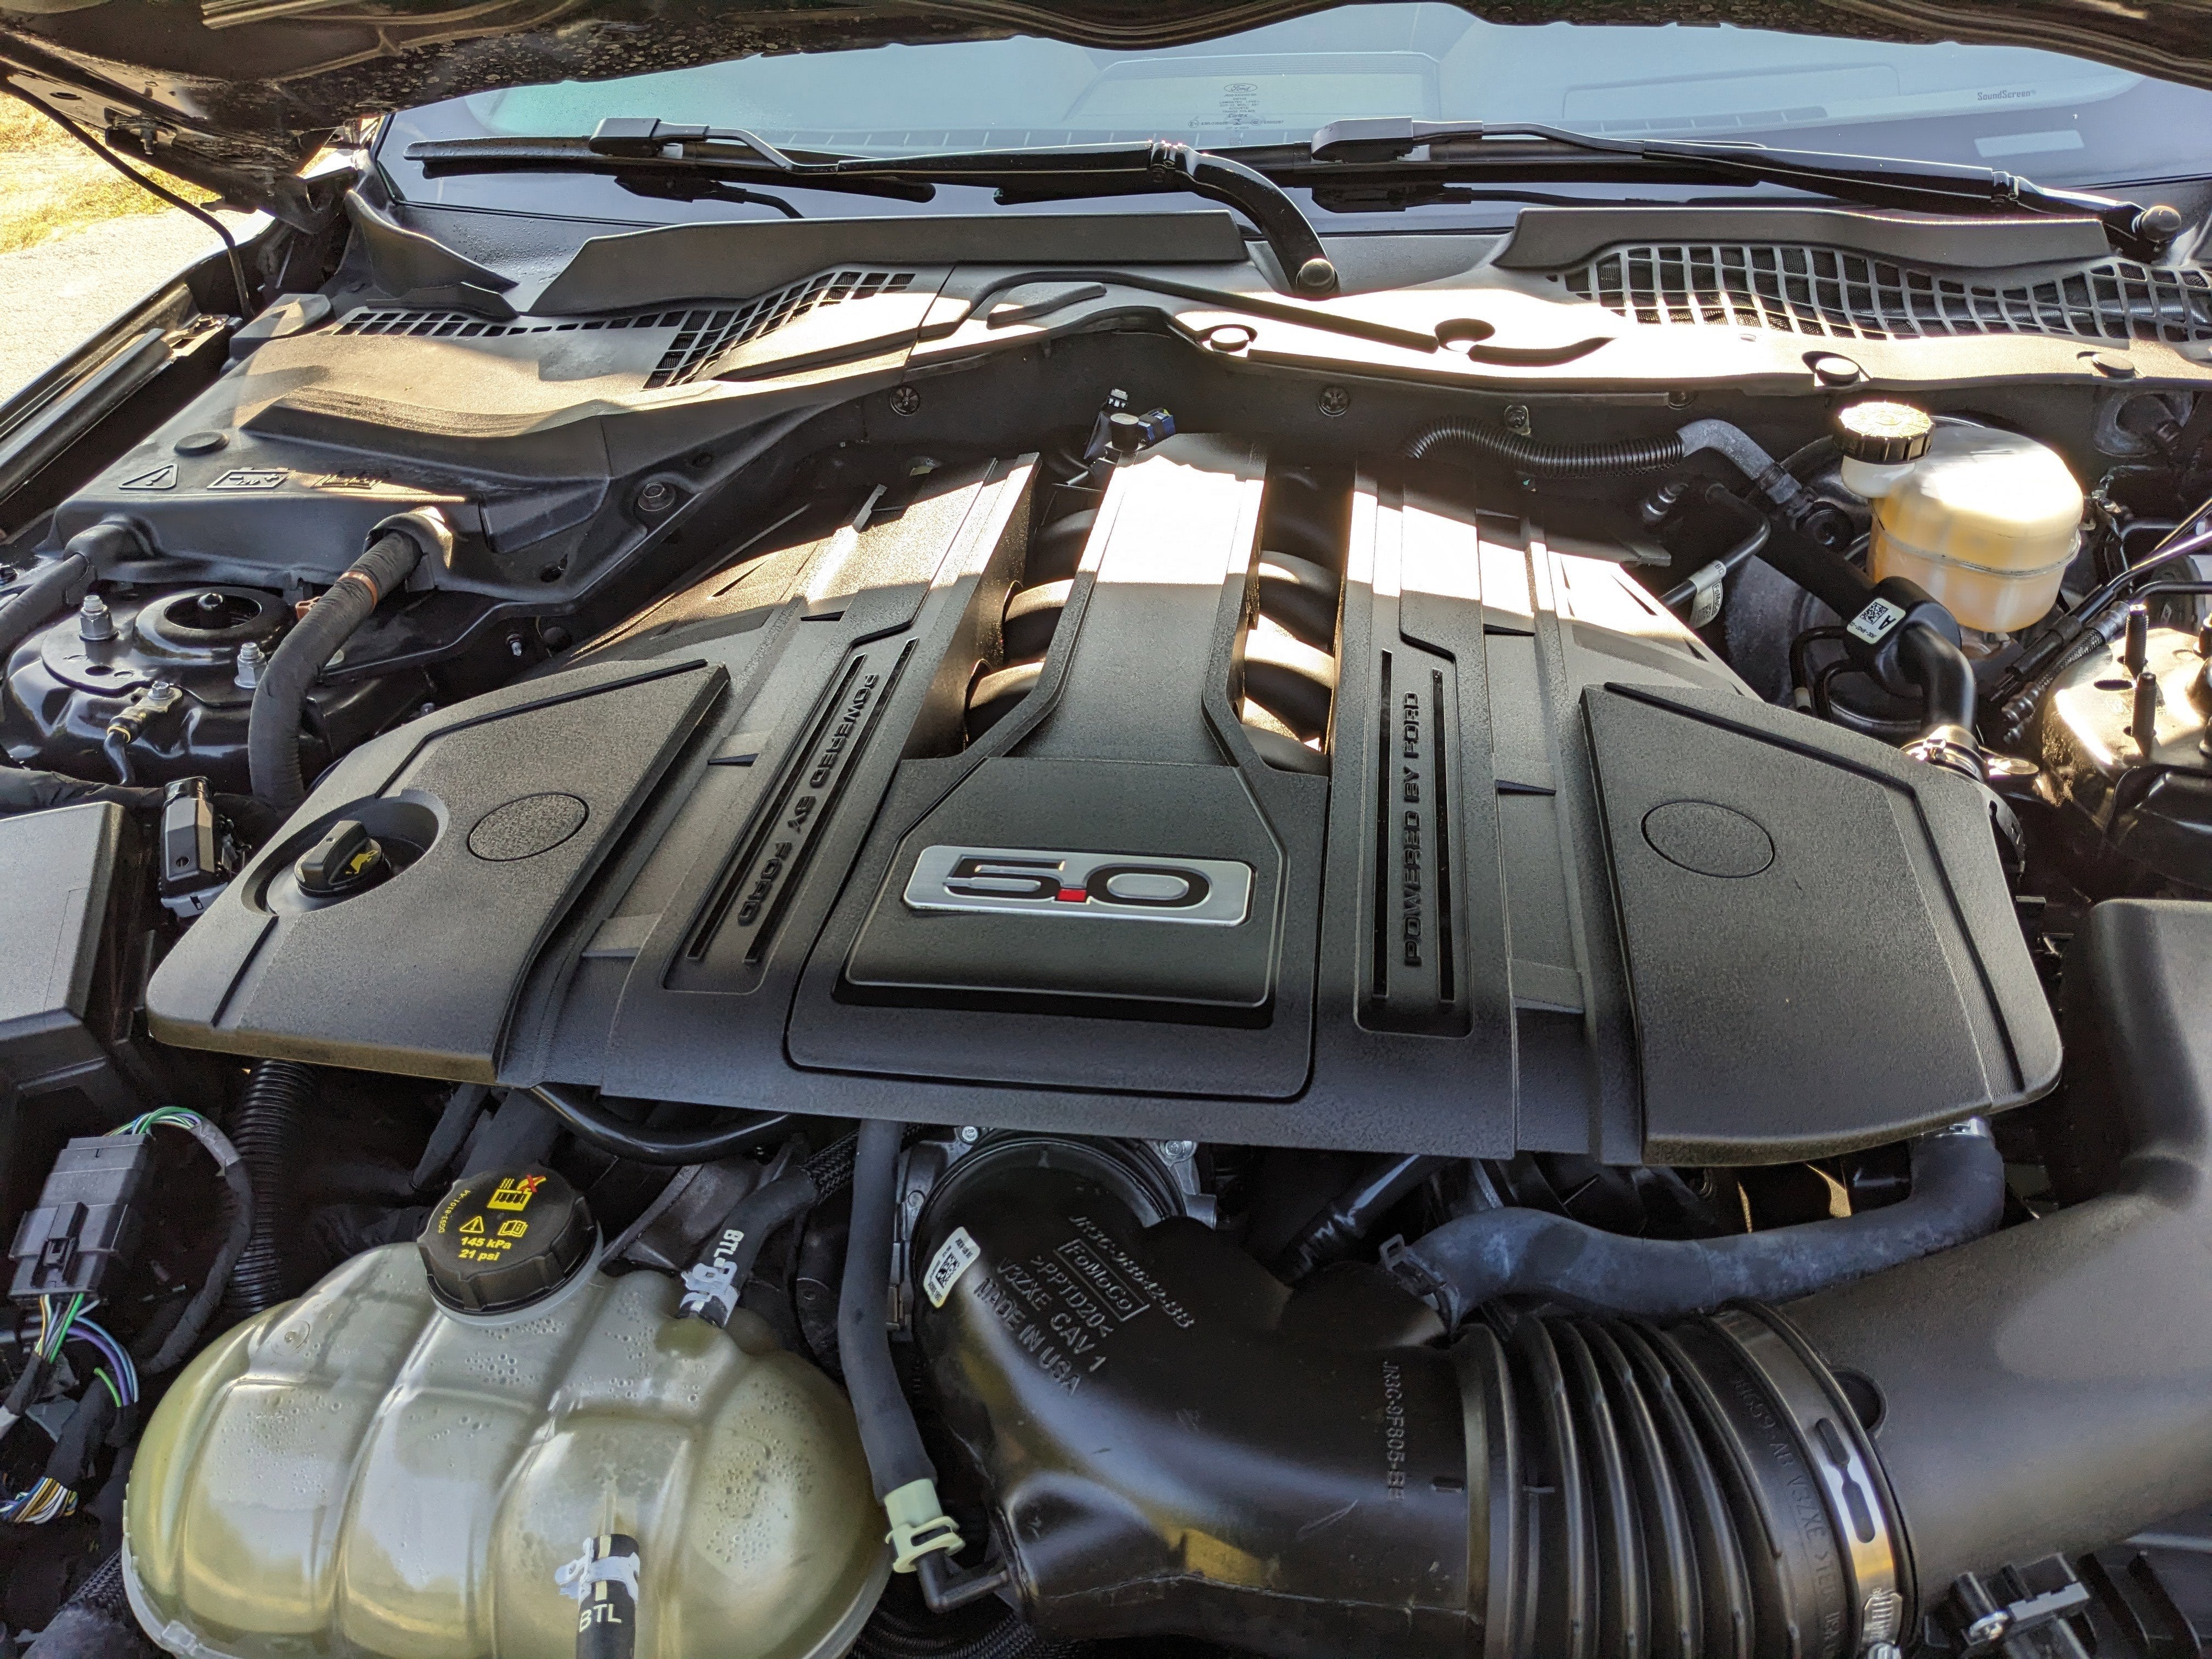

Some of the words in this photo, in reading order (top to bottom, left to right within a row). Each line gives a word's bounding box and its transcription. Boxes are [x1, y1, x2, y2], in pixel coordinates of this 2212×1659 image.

[1878, 614, 1897, 630] A
[809, 674, 879, 788] POWERED
[1403, 691, 1420, 759] FORD
[1403, 766, 1421, 803] BY
[787, 795, 816, 834] BY
[737, 842, 792, 926] FORD
[943, 854, 1212, 909] 5.0
[1403, 810, 1423, 966] POWERED
[459, 1249, 476, 1259] 21
[477, 1251, 500, 1261] psi
[460, 1237, 485, 1247] 145
[487, 1239, 511, 1250] kPa
[713, 1229, 744, 1258] BTL
[1066, 1244, 1134, 1312] FoMoCo
[973, 1278, 1027, 1331] MADE
[1019, 1323, 1046, 1352] IN
[1041, 1346, 1082, 1398] USA
[1050, 1313, 1096, 1355] CAV
[579, 1603, 622, 1633] BTL
